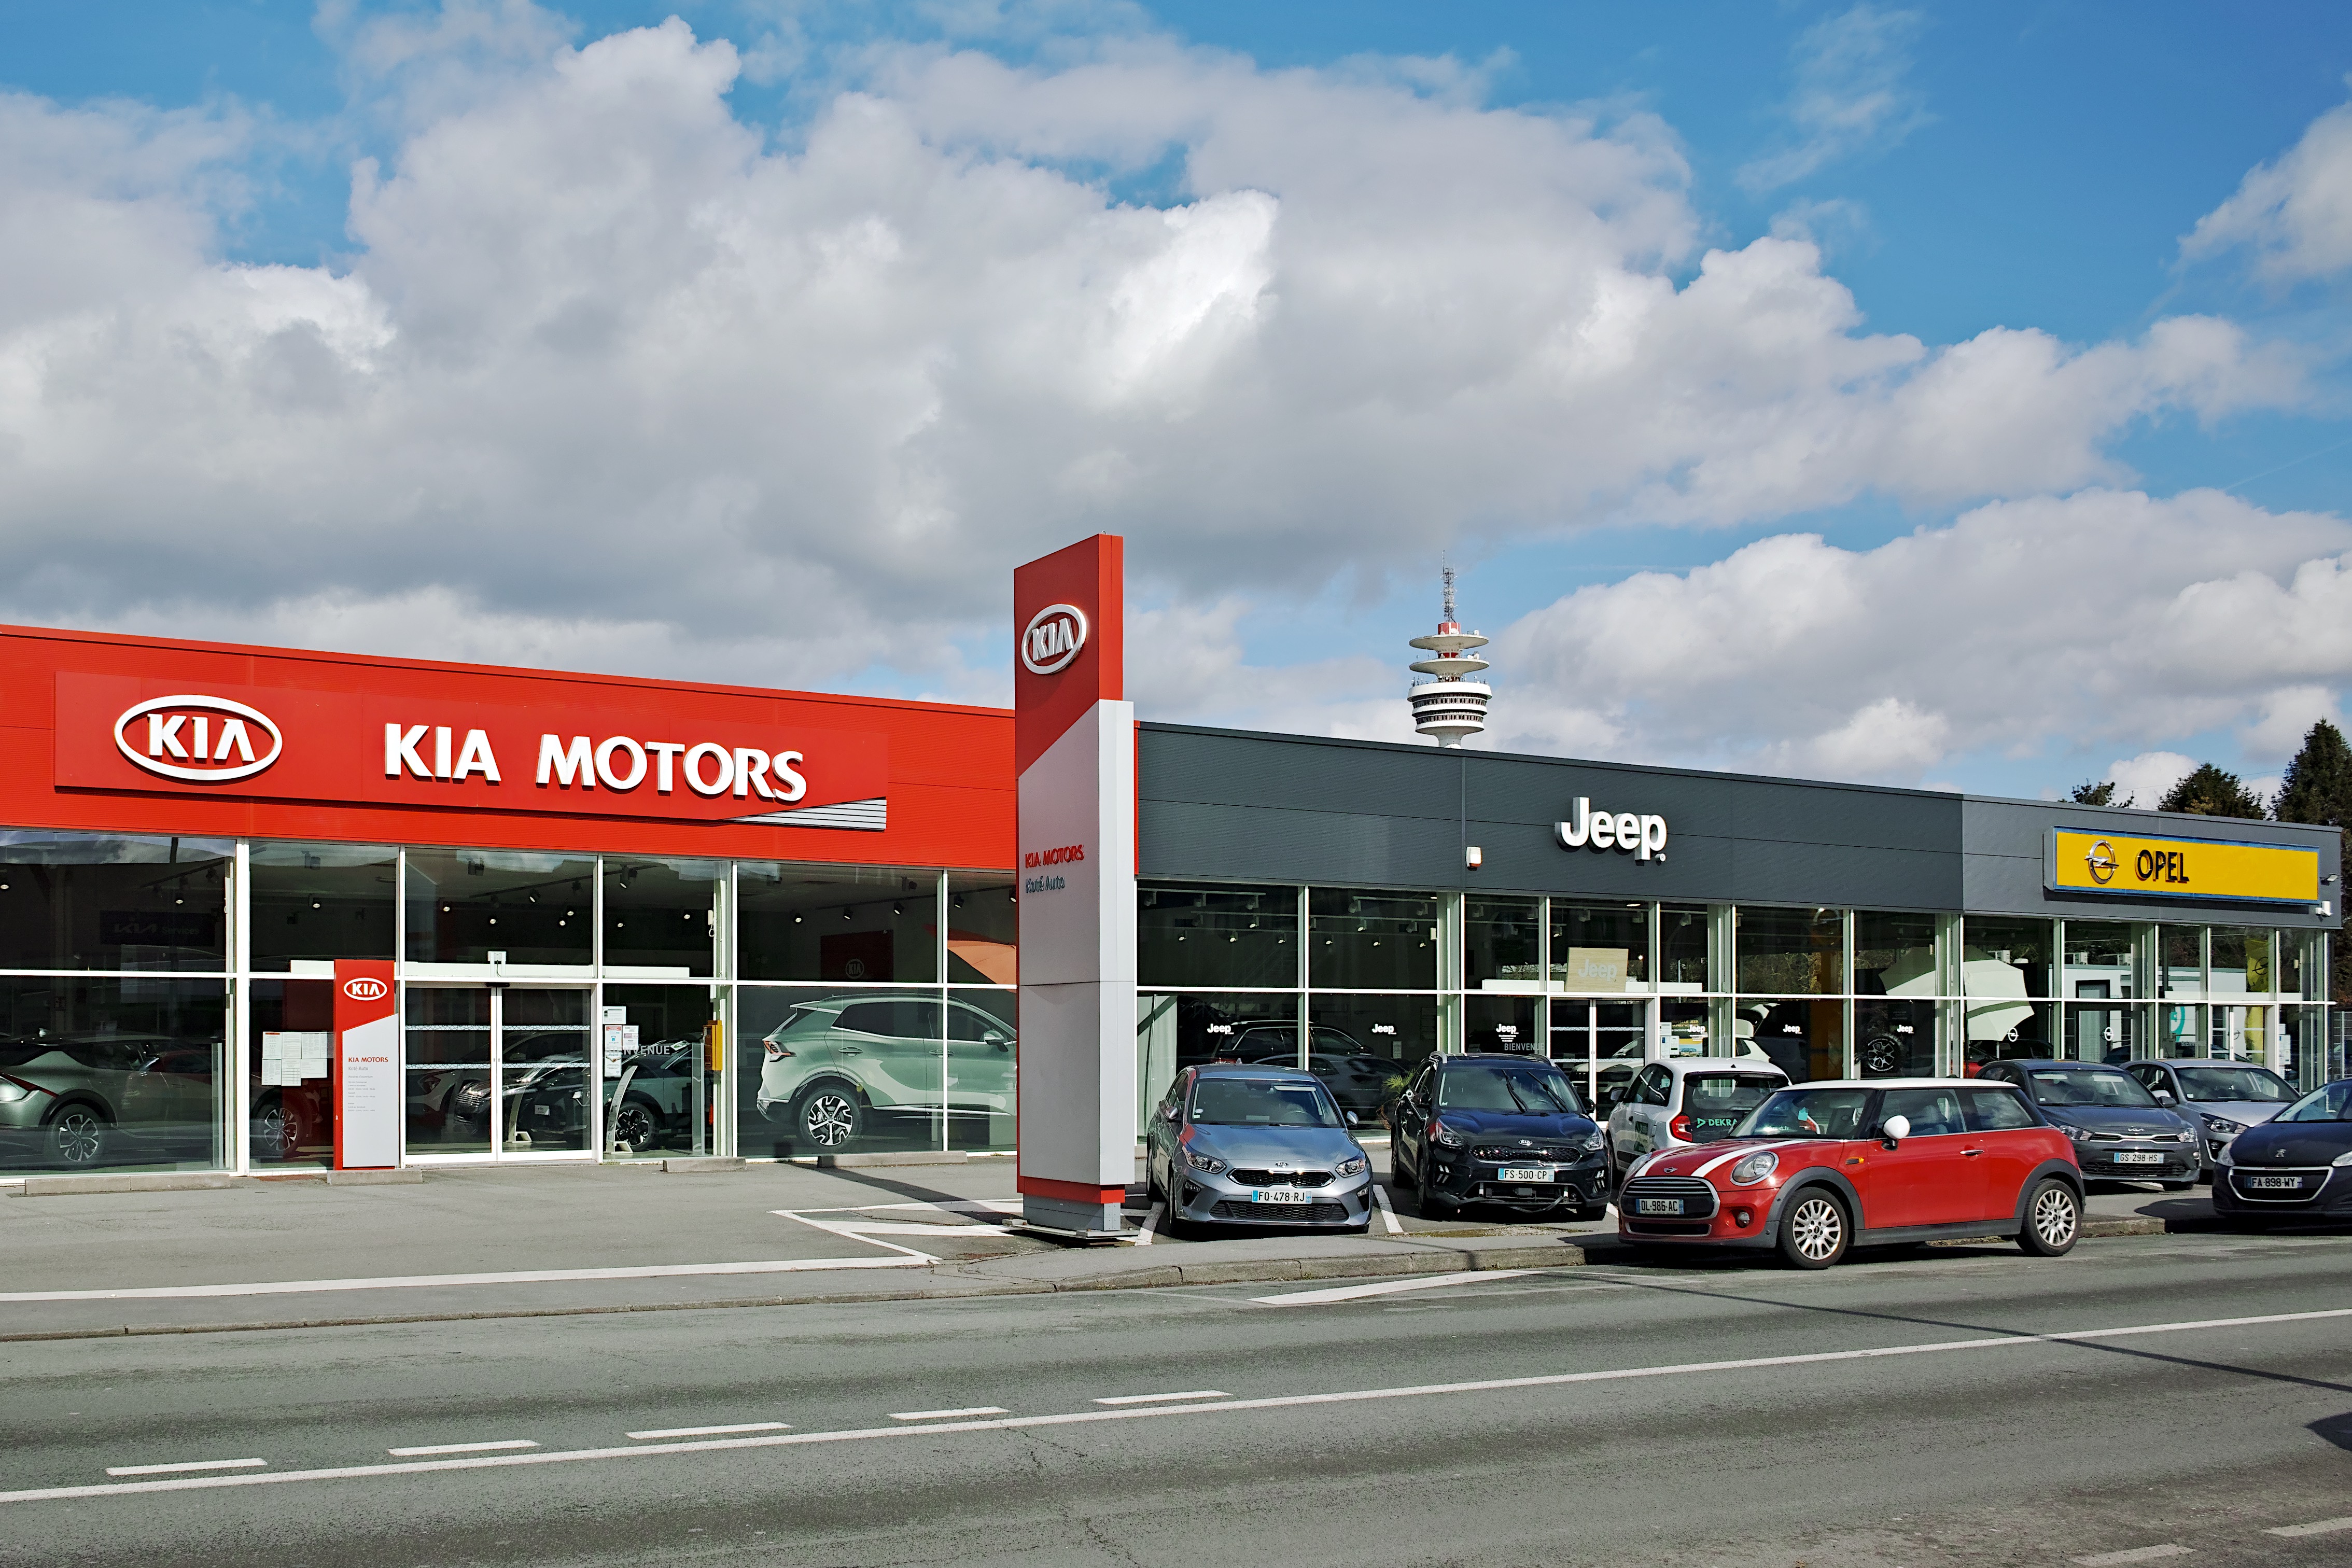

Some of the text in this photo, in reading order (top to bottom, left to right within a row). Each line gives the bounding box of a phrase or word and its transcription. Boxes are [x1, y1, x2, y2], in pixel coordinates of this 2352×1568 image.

[1031, 618, 1075, 662] KIA
[147, 713, 256, 762] KIA
[385, 723, 807, 802] KIA MOTORS
[1555, 796, 1667, 861] Jeep
[1025, 844, 1084, 868] KIA MOTORS
[2135, 849, 2190, 884] OPEL
[1025, 875, 1065, 893] Koté Auto
[849, 963, 862, 974] KIA
[1578, 959, 1617, 982] Jeep
[352, 983, 380, 995] KIA
[1207, 1024, 1231, 1034] Jeep
[1372, 1024, 1394, 1034] Jeep
[1496, 1024, 1517, 1034] Jeep
[1687, 1024, 1706, 1034] Jeep
[1783, 1025, 1800, 1034] Jeep
[1897, 1025, 1913, 1033] Jeep
[1505, 1170, 1547, 1180] FS-500-CP
[2252, 1178, 2295, 1187] FA-898-WY
[1258, 1192, 1305, 1202] FQ-478-RJ
[1641, 1200, 1678, 1211] DL-986-AC
